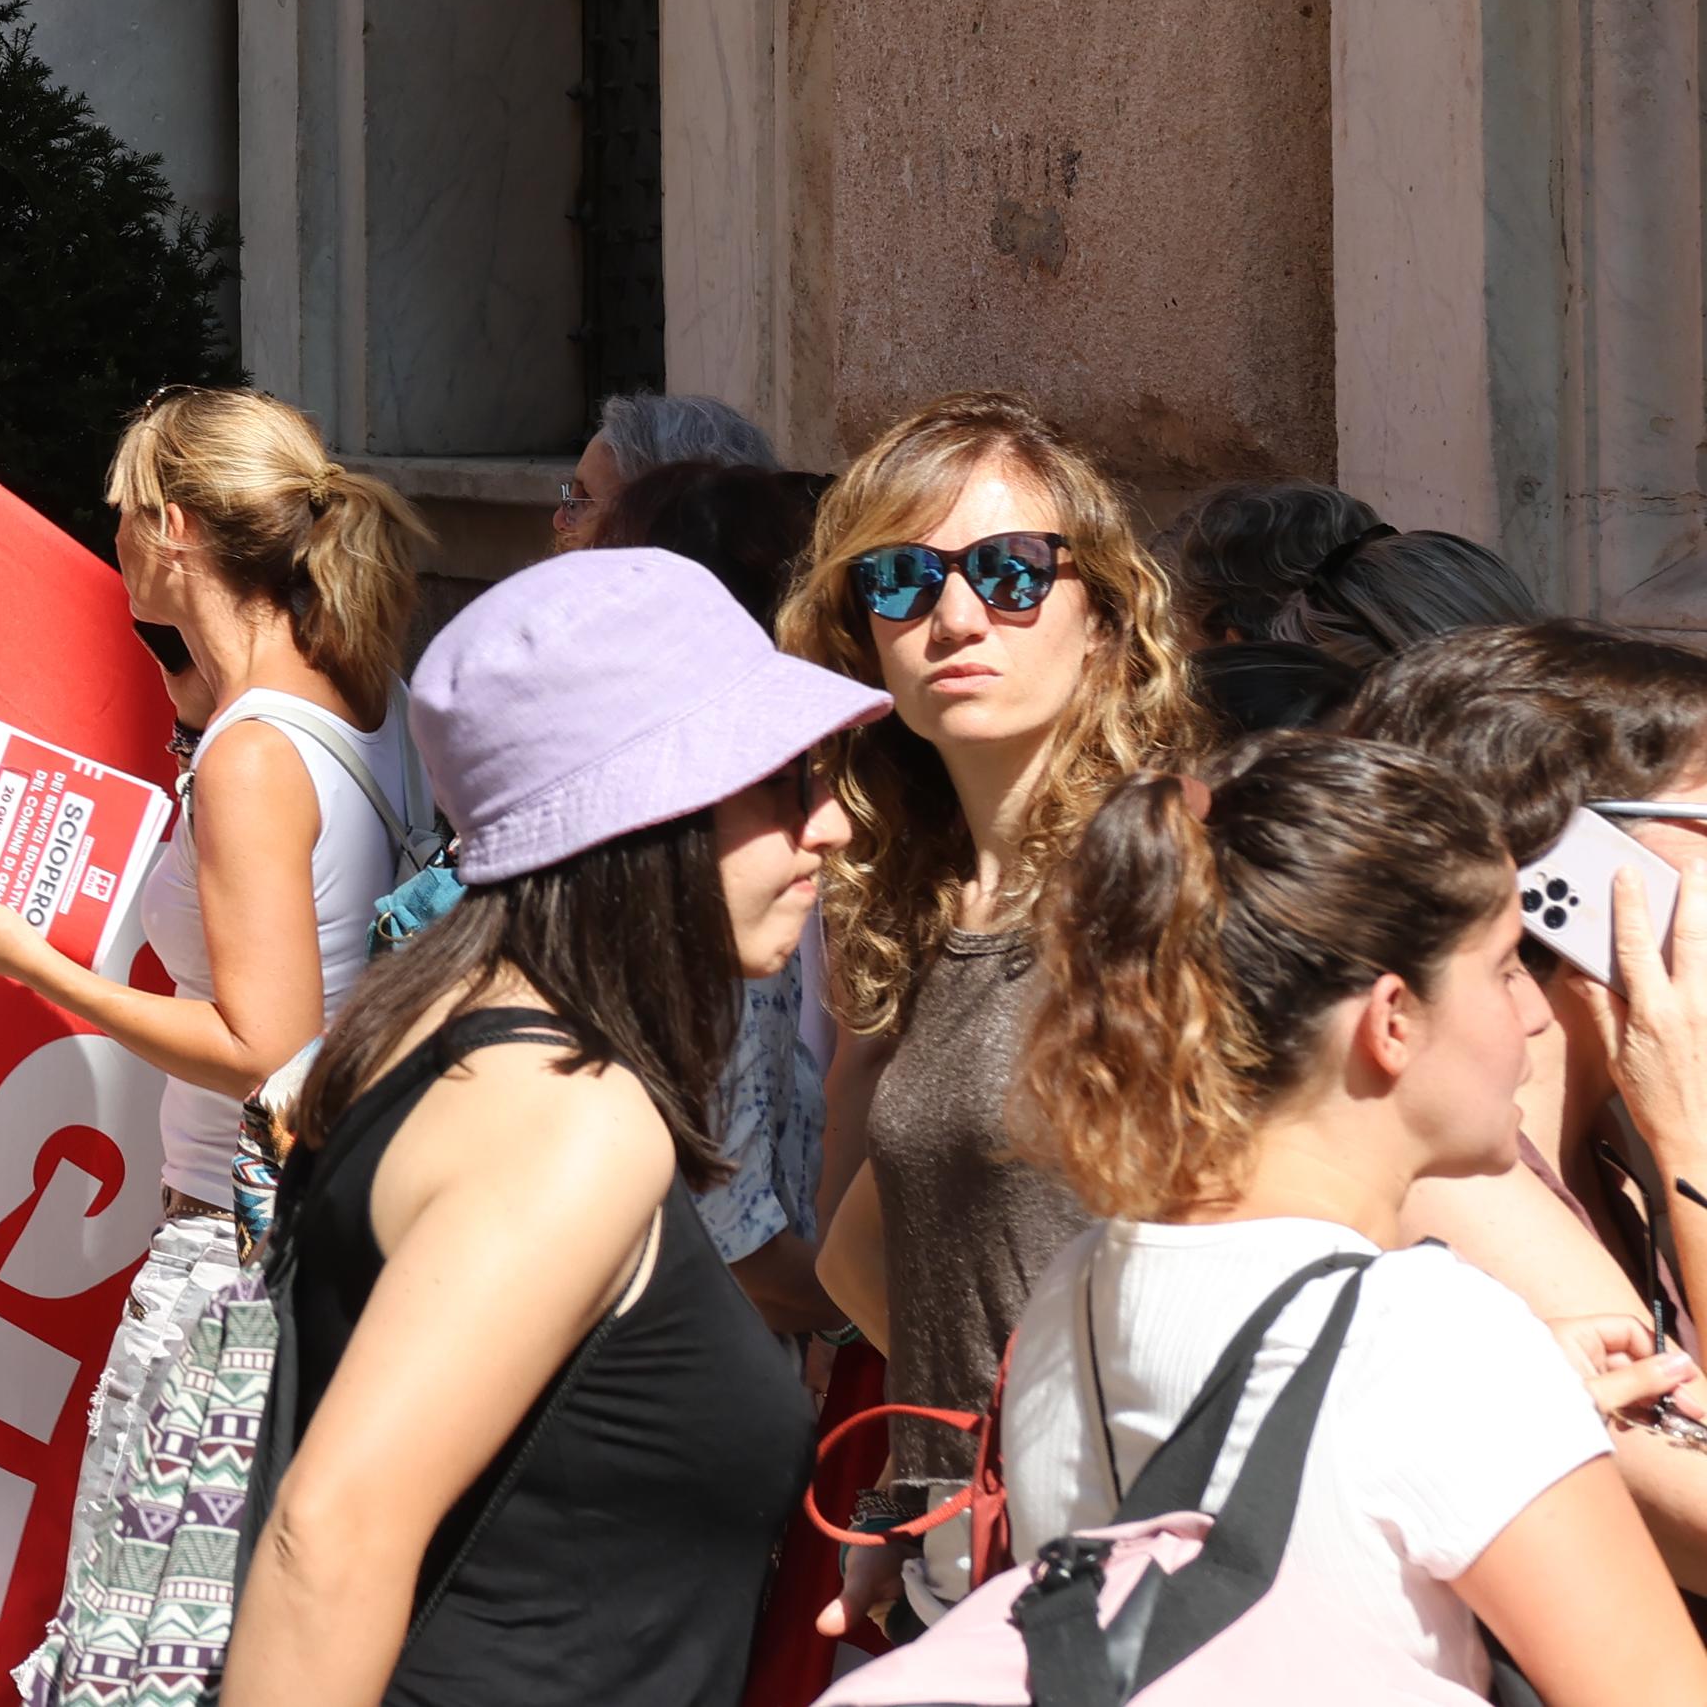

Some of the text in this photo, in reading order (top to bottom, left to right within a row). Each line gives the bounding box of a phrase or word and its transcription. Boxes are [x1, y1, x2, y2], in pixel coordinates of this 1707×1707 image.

[0, 784, 15, 803] 20
[28, 768, 48, 794] DEL
[48, 770, 67, 793] DEI
[6, 794, 38, 855] COMUNE
[29, 793, 57, 844] SERVIZI
[0, 855, 15, 871] DI
[23, 801, 86, 929] SCIOPERO
[92, 872, 112, 897] FP
